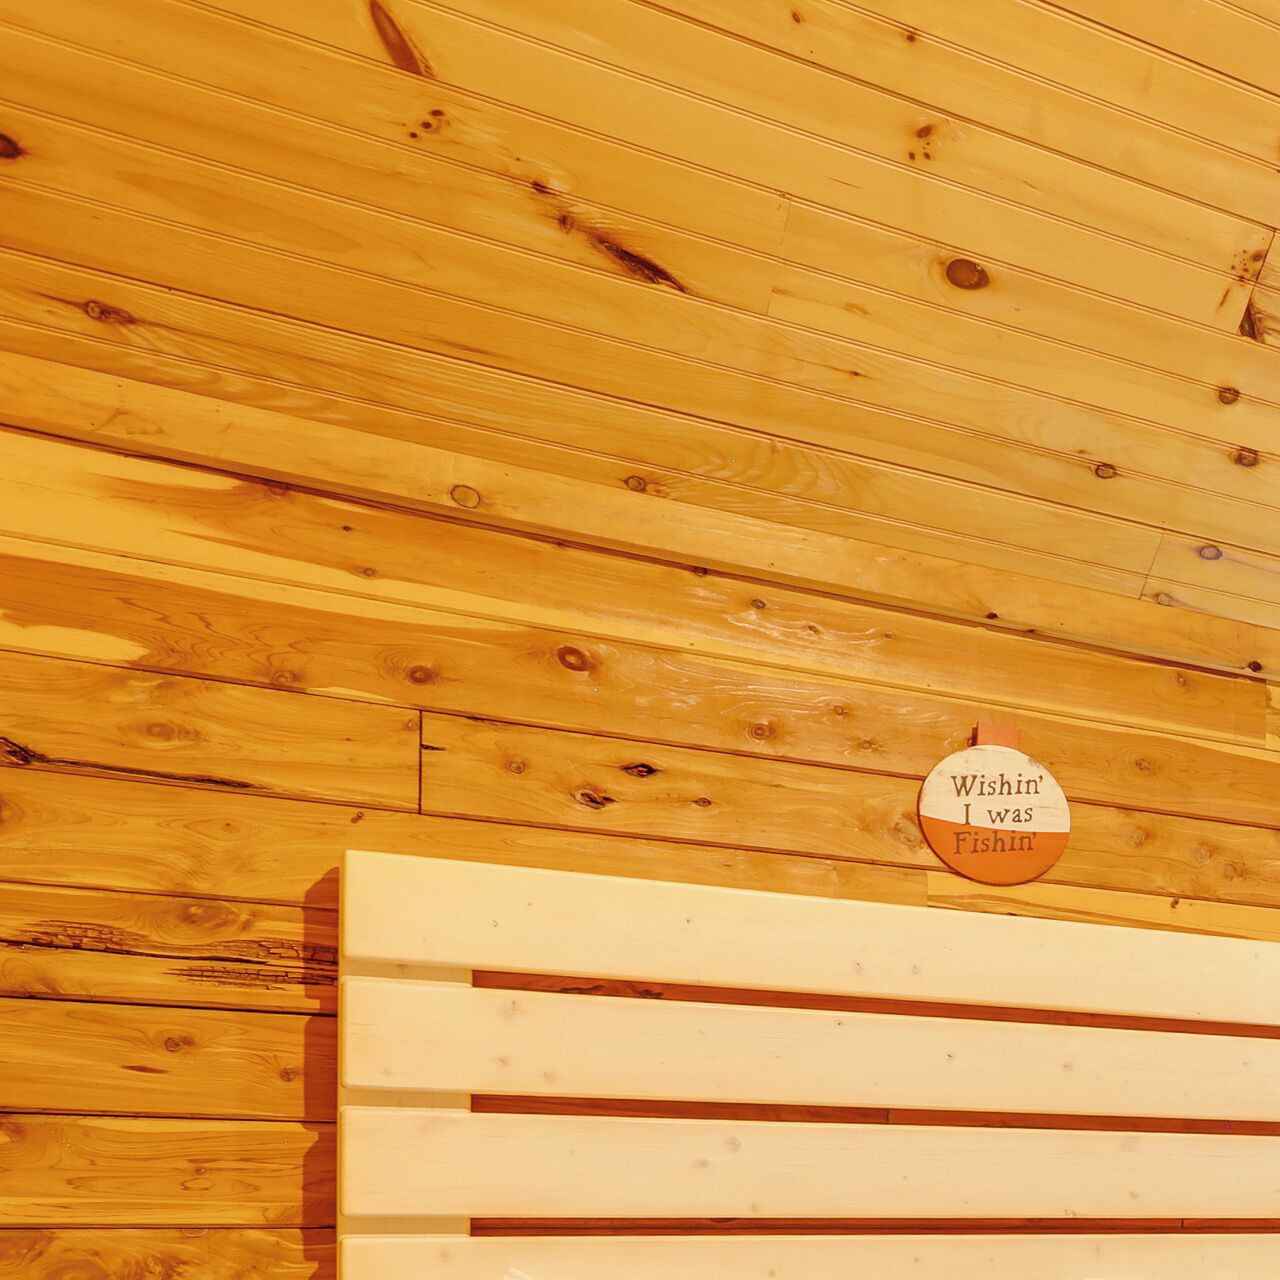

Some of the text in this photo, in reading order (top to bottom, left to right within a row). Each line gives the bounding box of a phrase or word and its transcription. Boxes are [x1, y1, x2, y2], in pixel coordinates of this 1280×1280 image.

[951, 773, 1043, 797] Wishin'
[963, 803, 1034, 826] I was
[953, 830, 1037, 855] Fishin'
